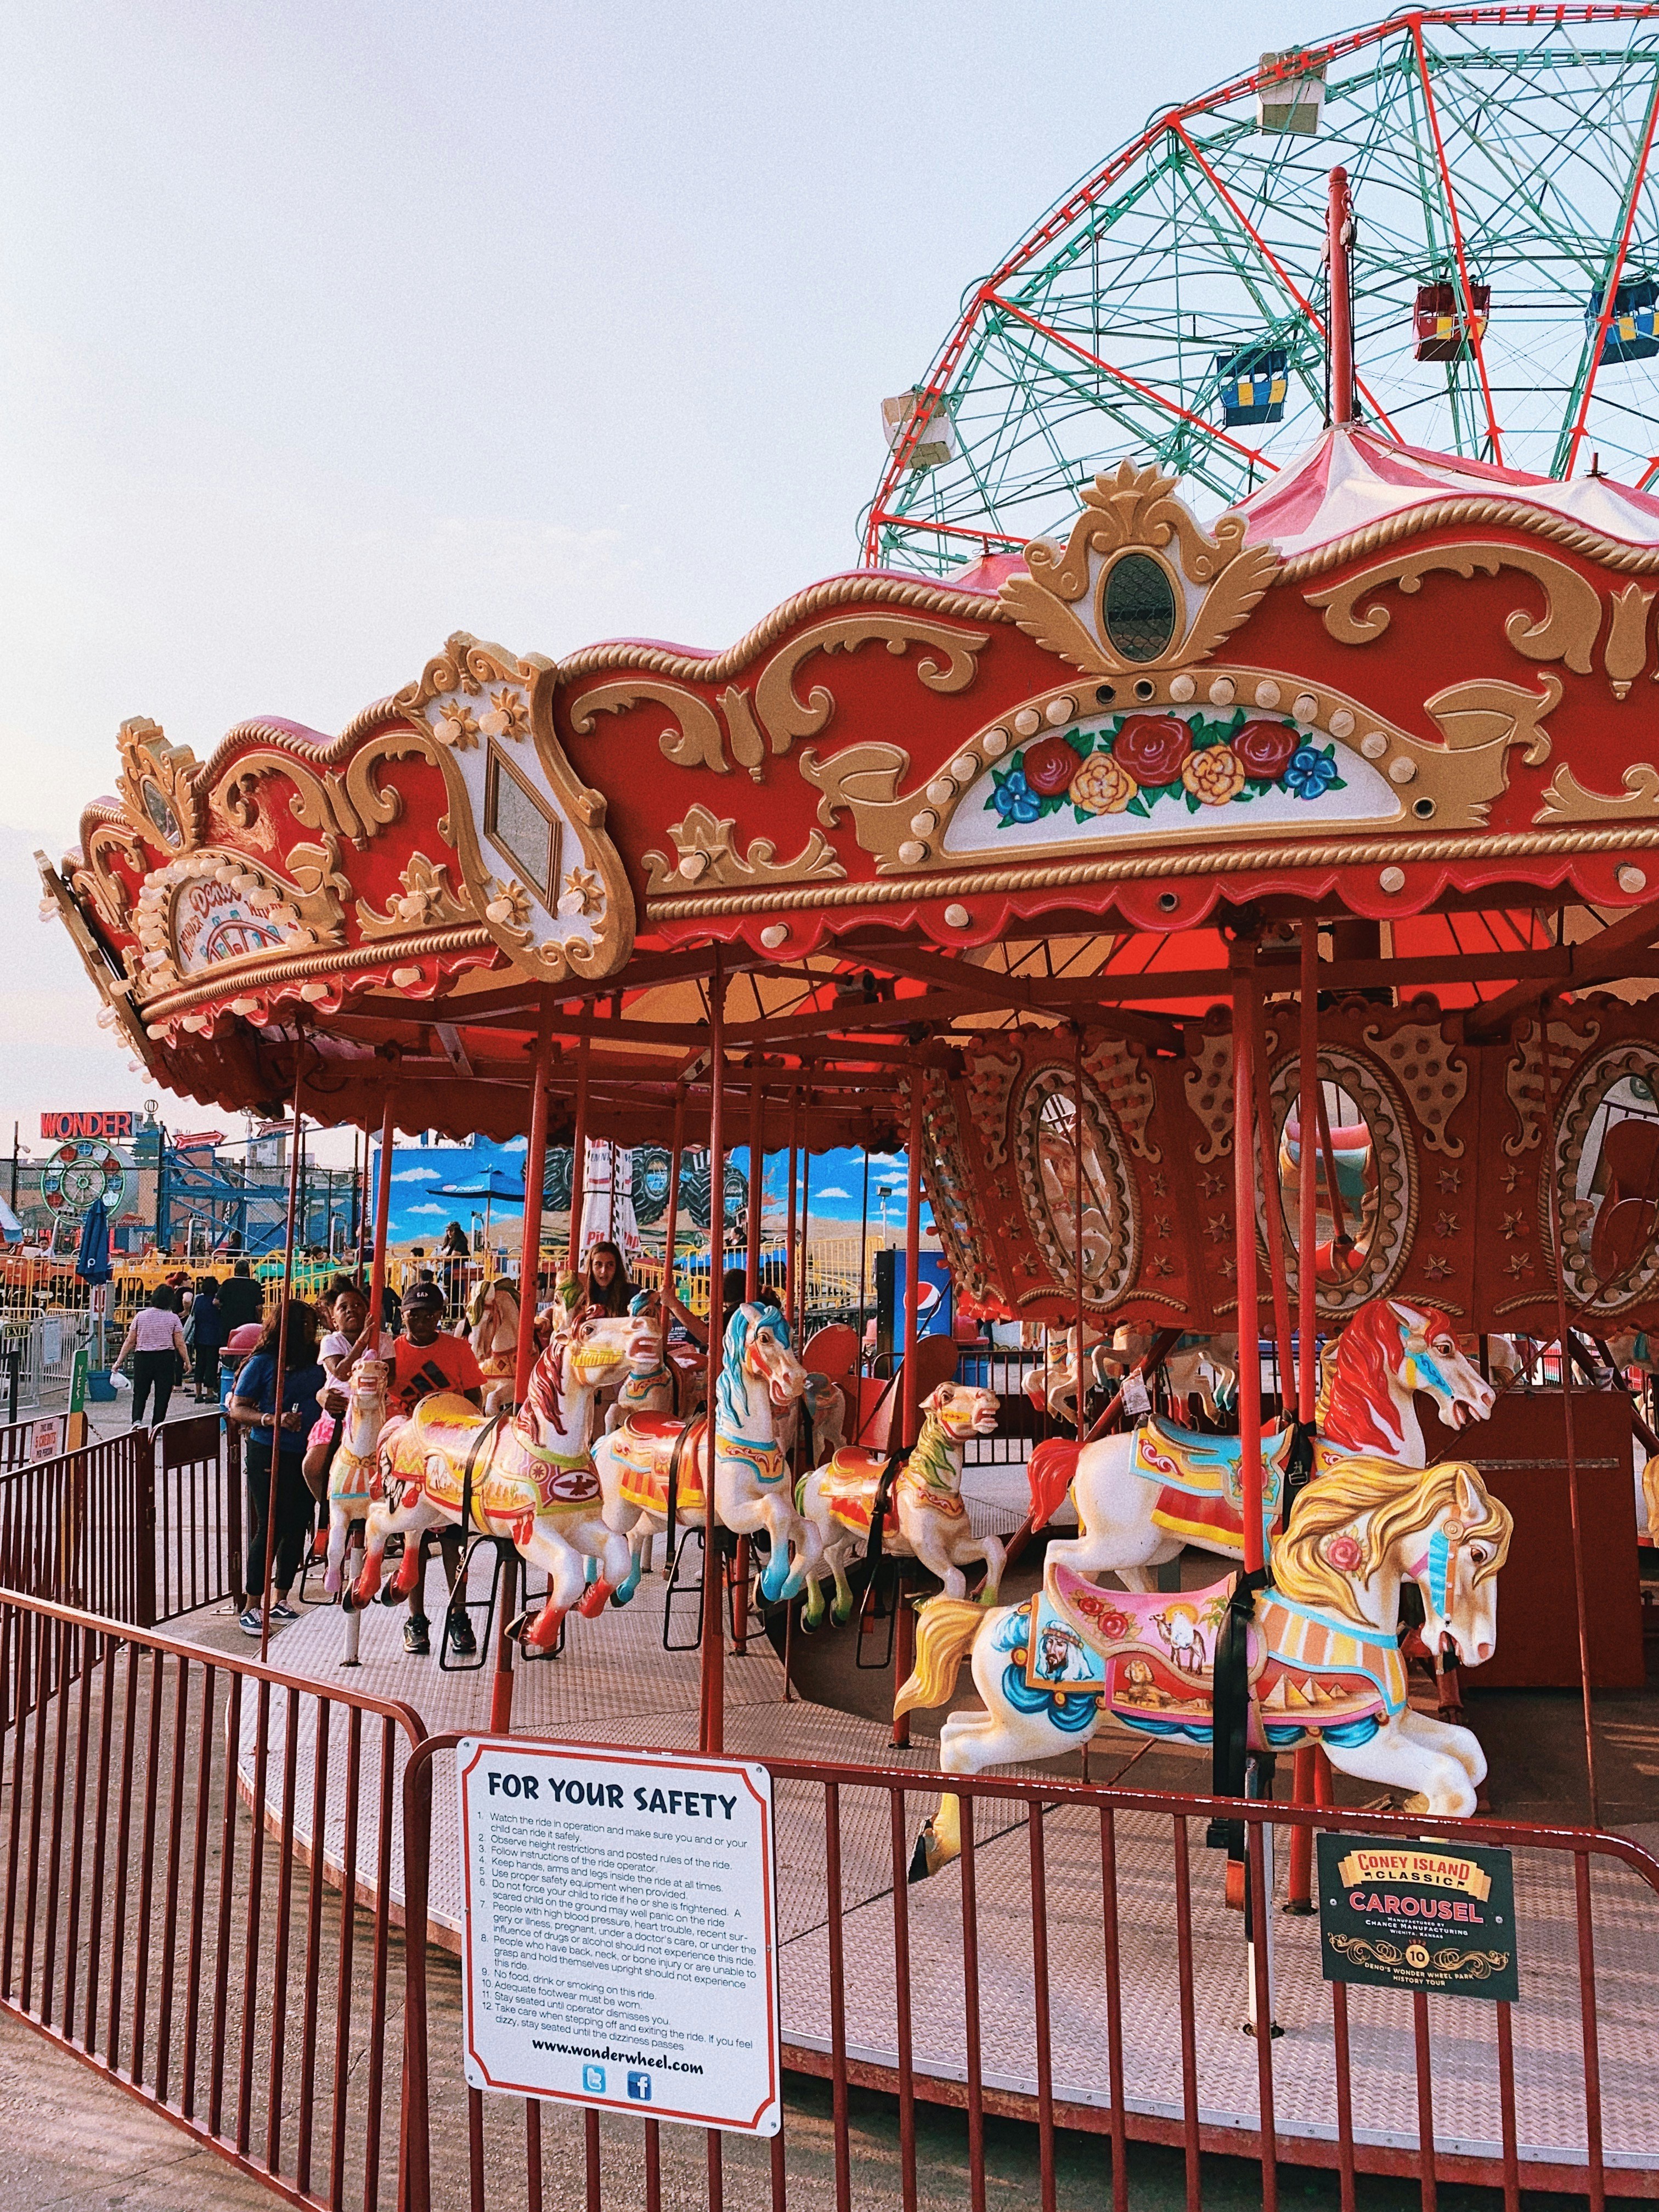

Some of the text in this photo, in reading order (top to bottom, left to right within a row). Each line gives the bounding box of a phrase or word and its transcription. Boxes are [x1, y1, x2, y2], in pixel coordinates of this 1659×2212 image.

[41, 1113, 131, 1138] WONDER
[7, 1327, 26, 1337] EXIT
[488, 1772, 737, 1820] FOR YOUR SAFETY
[489, 1812, 748, 1848] Watch ride operation make sure you your
[490, 1824, 582, 1843] child ride safely.
[490, 1834, 732, 1870] Observe height restrictions posted rules ride.
[490, 1845, 658, 1874] Follow instructions ride operator.
[1358, 1854, 1470, 1880] CONEY ISLAND
[491, 1857, 723, 1892] Keep hands, arms legs inside ride all times.
[492, 1867, 644, 1894] Use proper safety equipment when
[1376, 1871, 1453, 1886] CLASSIC
[492, 1892, 725, 1927] scared child ground may well panic ride
[522, 1882, 729, 1916] force your child ride she frightened.
[1349, 1892, 1484, 1923] CAROUSEL
[492, 1901, 748, 1941] People with high blood pressure, heart trouble, recent sur-
[493, 1914, 739, 1953] gery under doctor's care, under
[1365, 1919, 1468, 1936] CHANCE MANUFACTURING
[1387, 1917, 1435, 1927] MANUFACTURED
[493, 1923, 755, 1966] influence drugs alcohol should experience this ride.
[493, 1934, 744, 1977] People who have bone injury unable
[1409, 1951, 1425, 1962] 10
[493, 1948, 746, 1989] grasp hold themselves upright should experience
[494, 1957, 529, 1971] this ride.
[1364, 1962, 1391, 1972] DENO'S
[1393, 1968, 1425, 1977] WONDER
[494, 1980, 642, 2010] Adequate footwear must worn.
[508, 1971, 657, 2000] food, drink smoking this ride.
[1393, 1976, 1424, 1984] HISTORY
[494, 1991, 650, 2022] Stay seated until operator dismisses
[494, 2002, 753, 2049] Take care when stepping off exiting ride. you feel
[495, 2015, 650, 2046] dizzy, stay seated until dizziness
[532, 2039, 703, 2075] www.wonderwheel.com
